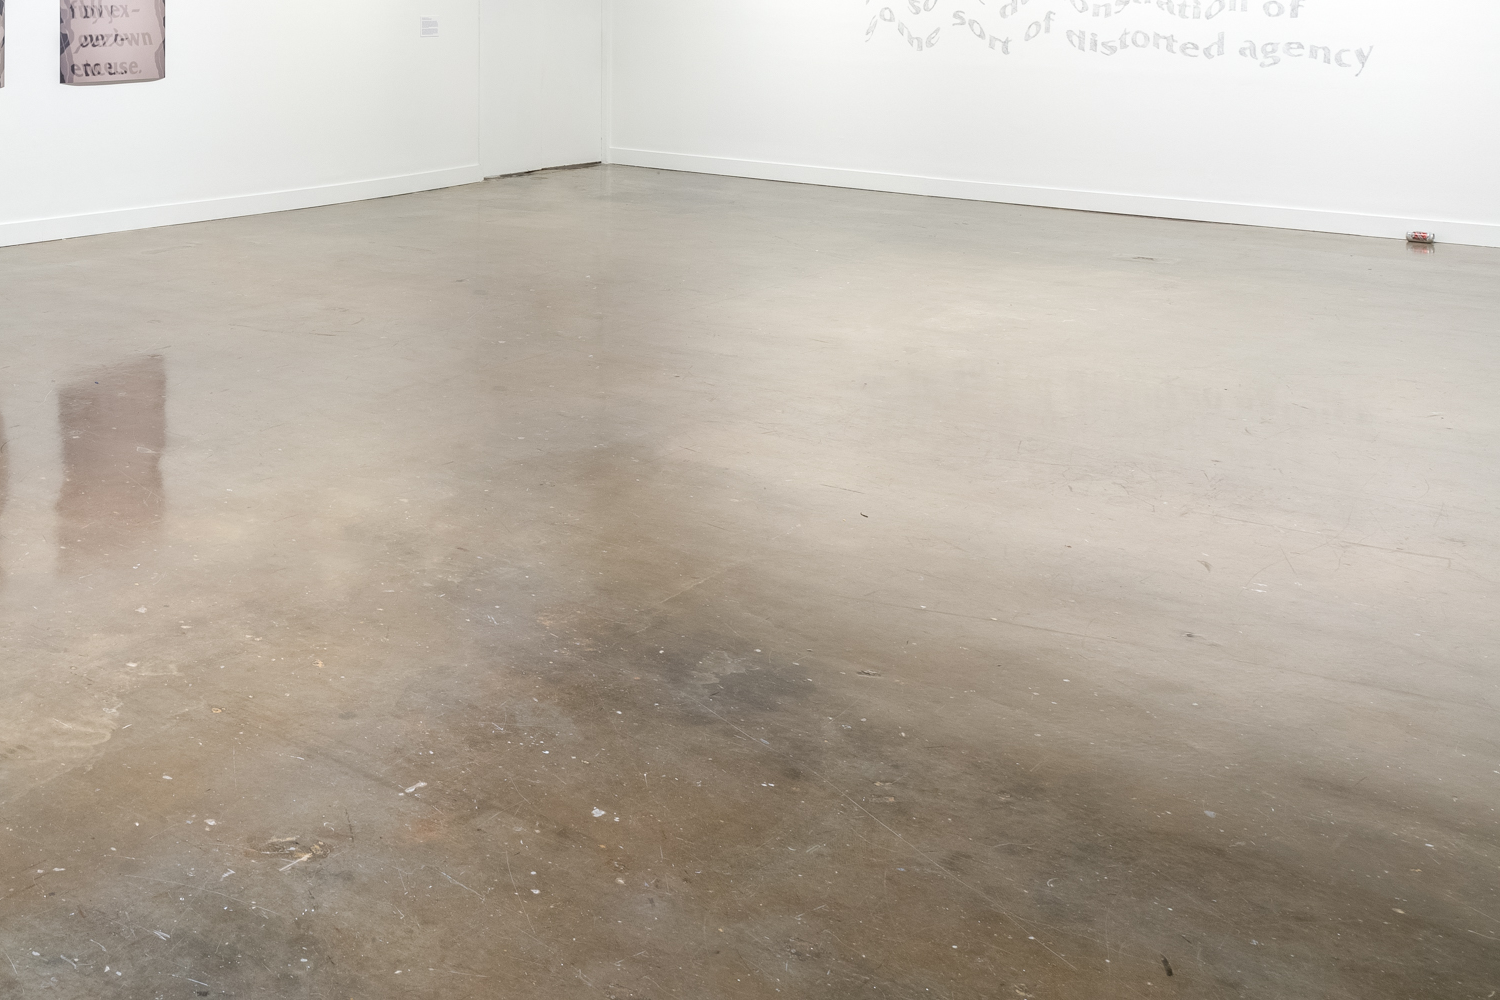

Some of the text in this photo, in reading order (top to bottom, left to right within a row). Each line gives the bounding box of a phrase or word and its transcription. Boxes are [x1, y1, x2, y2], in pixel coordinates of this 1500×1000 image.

[952, 10, 1012, 55] sort
[1023, 10, 1056, 42] of
[1065, 27, 1225, 60] distorted
[1238, 39, 1374, 77] agency
